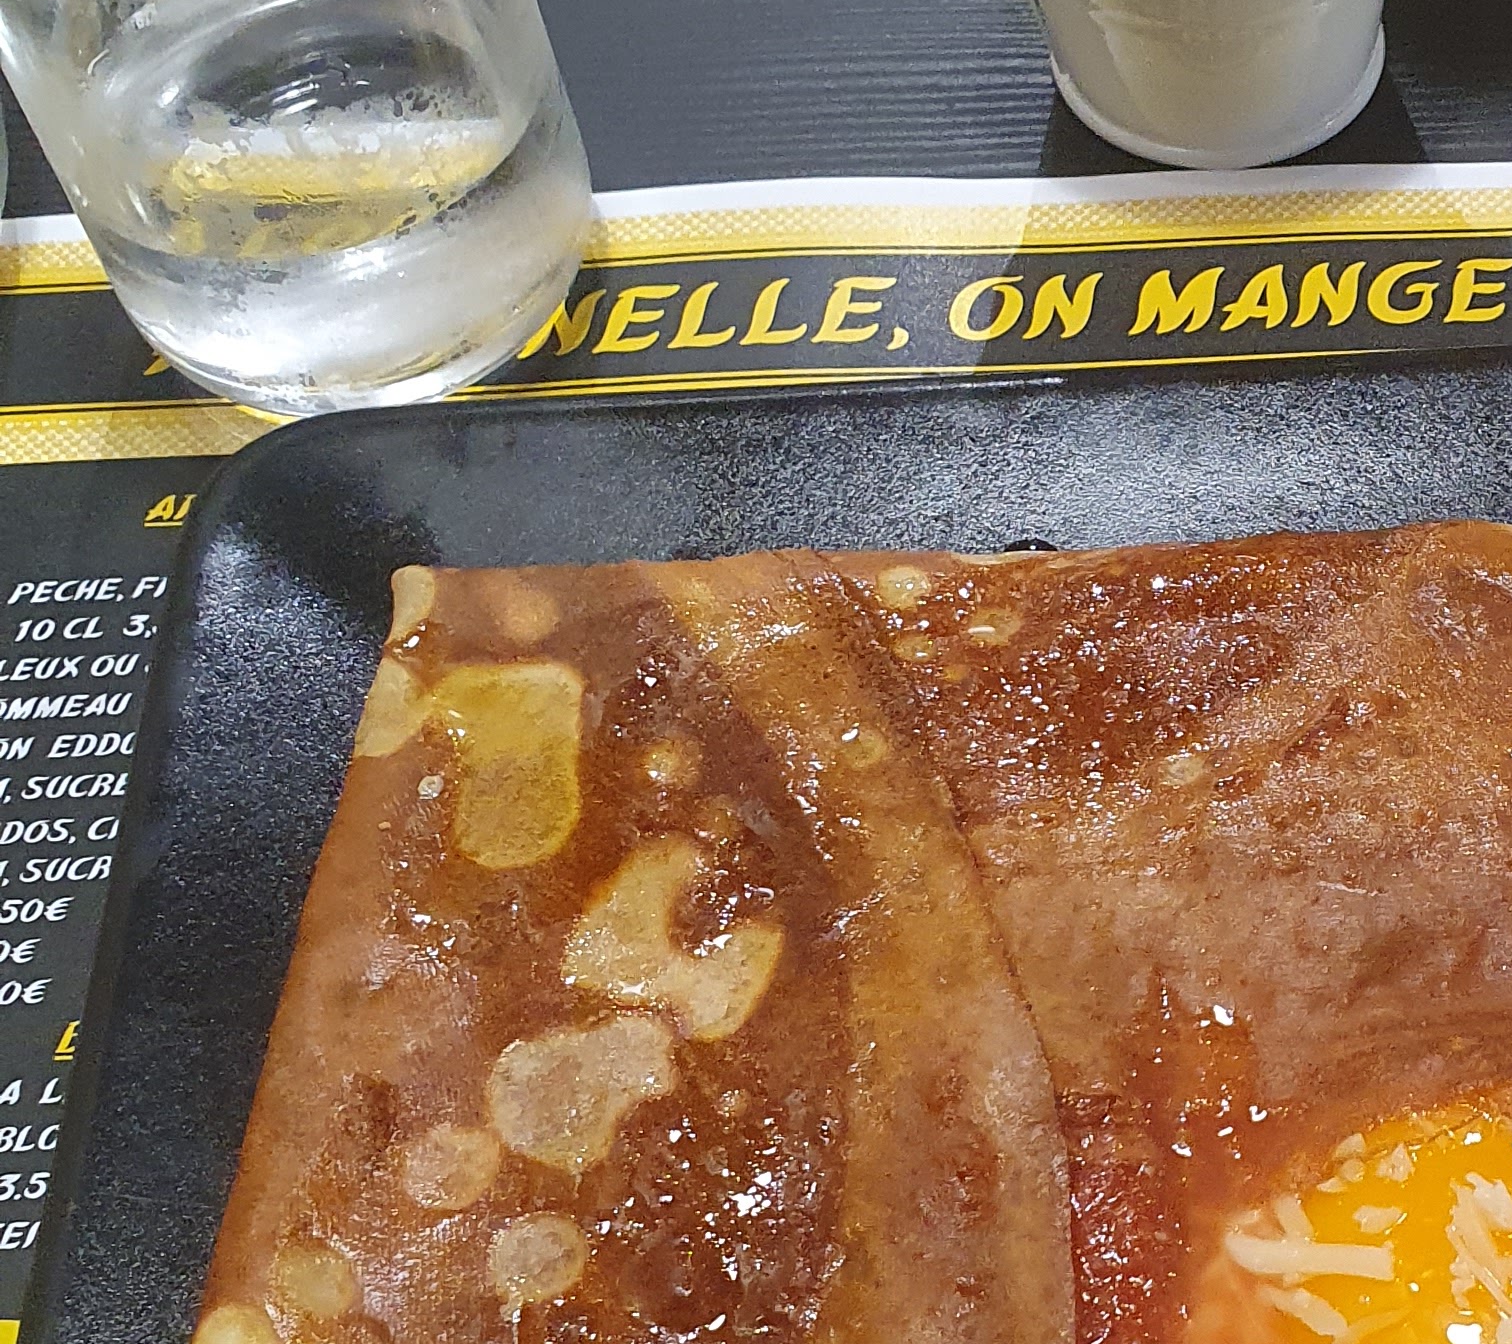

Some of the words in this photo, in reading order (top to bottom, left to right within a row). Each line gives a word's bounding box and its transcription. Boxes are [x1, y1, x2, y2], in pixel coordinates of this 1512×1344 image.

[947, 269, 1105, 343] ON
[7, 577, 125, 605] PECHE,
[15, 618, 57, 642] 10
[62, 616, 104, 640] CL
[90, 653, 141, 677] OU
